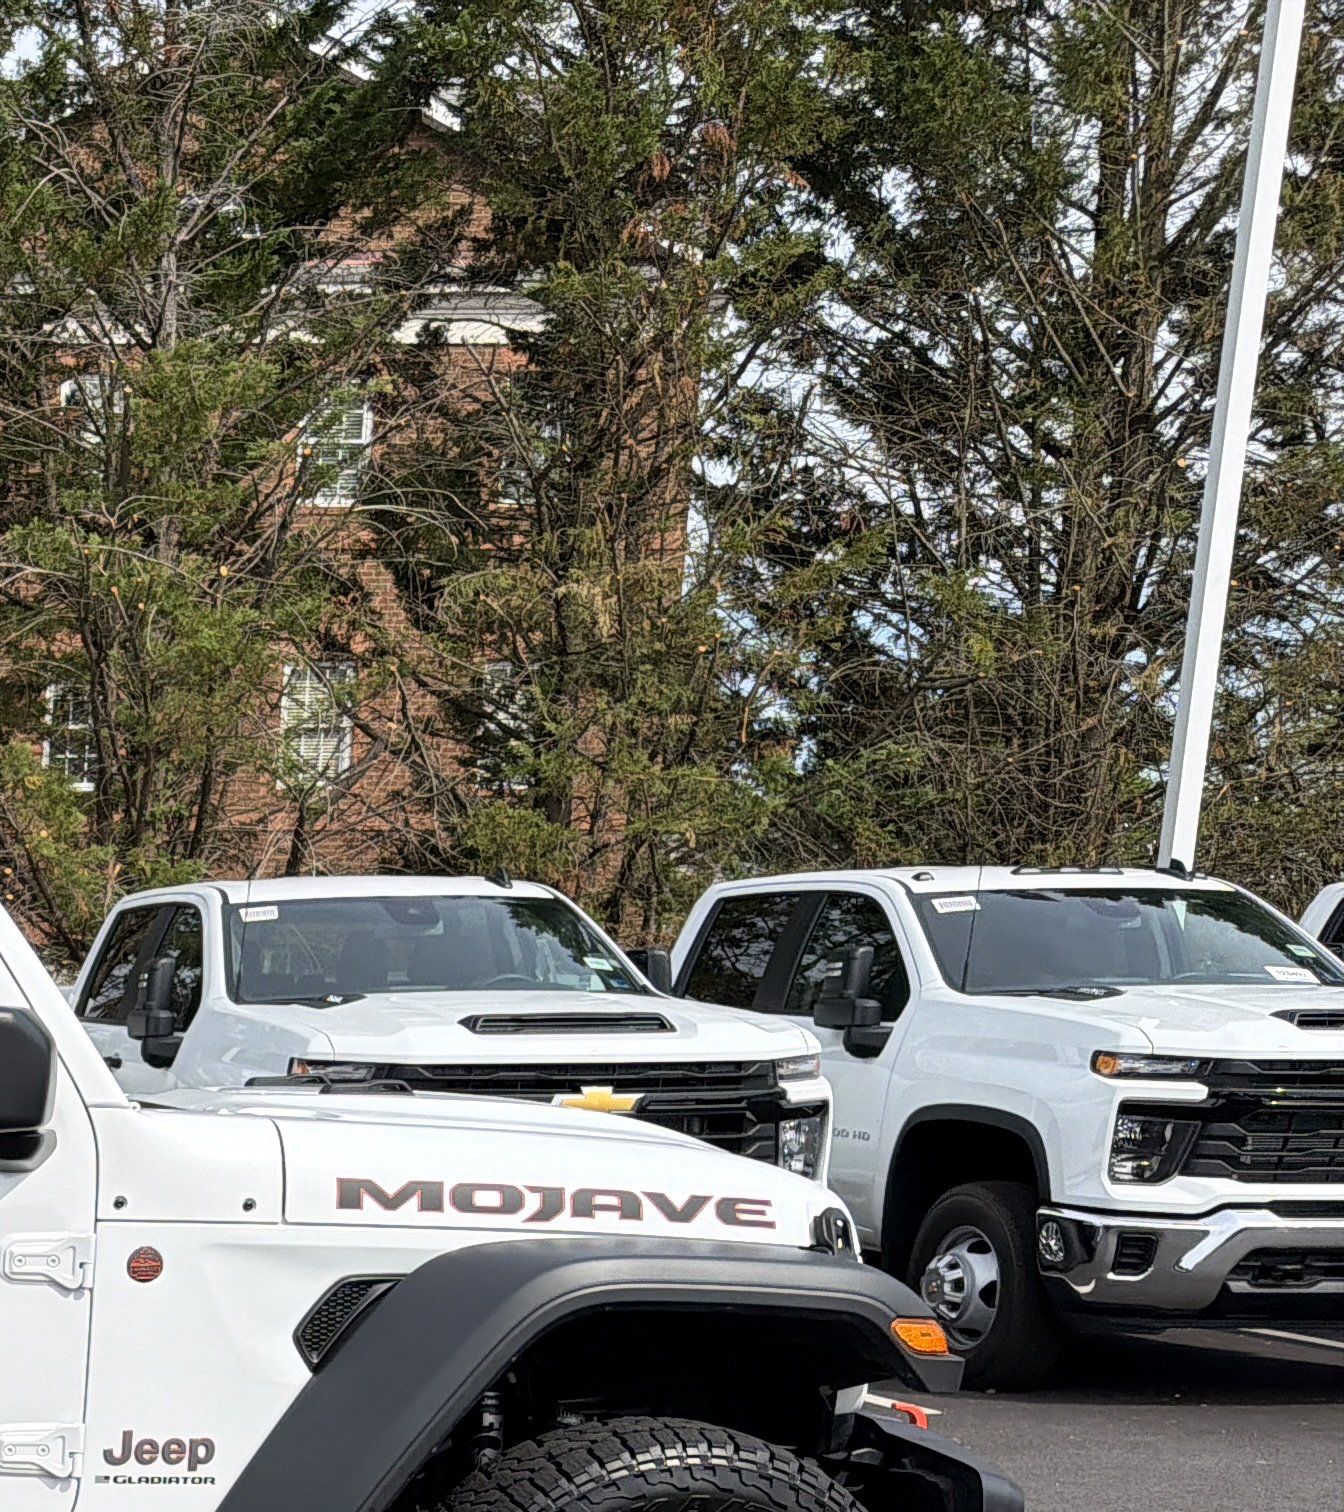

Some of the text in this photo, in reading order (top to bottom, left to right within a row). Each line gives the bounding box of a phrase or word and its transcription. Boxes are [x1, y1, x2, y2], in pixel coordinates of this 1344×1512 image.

[335, 1176, 777, 1230] MOJAVE
[102, 1429, 216, 1472] Jeep
[112, 1474, 216, 1486] GLADIATOR
